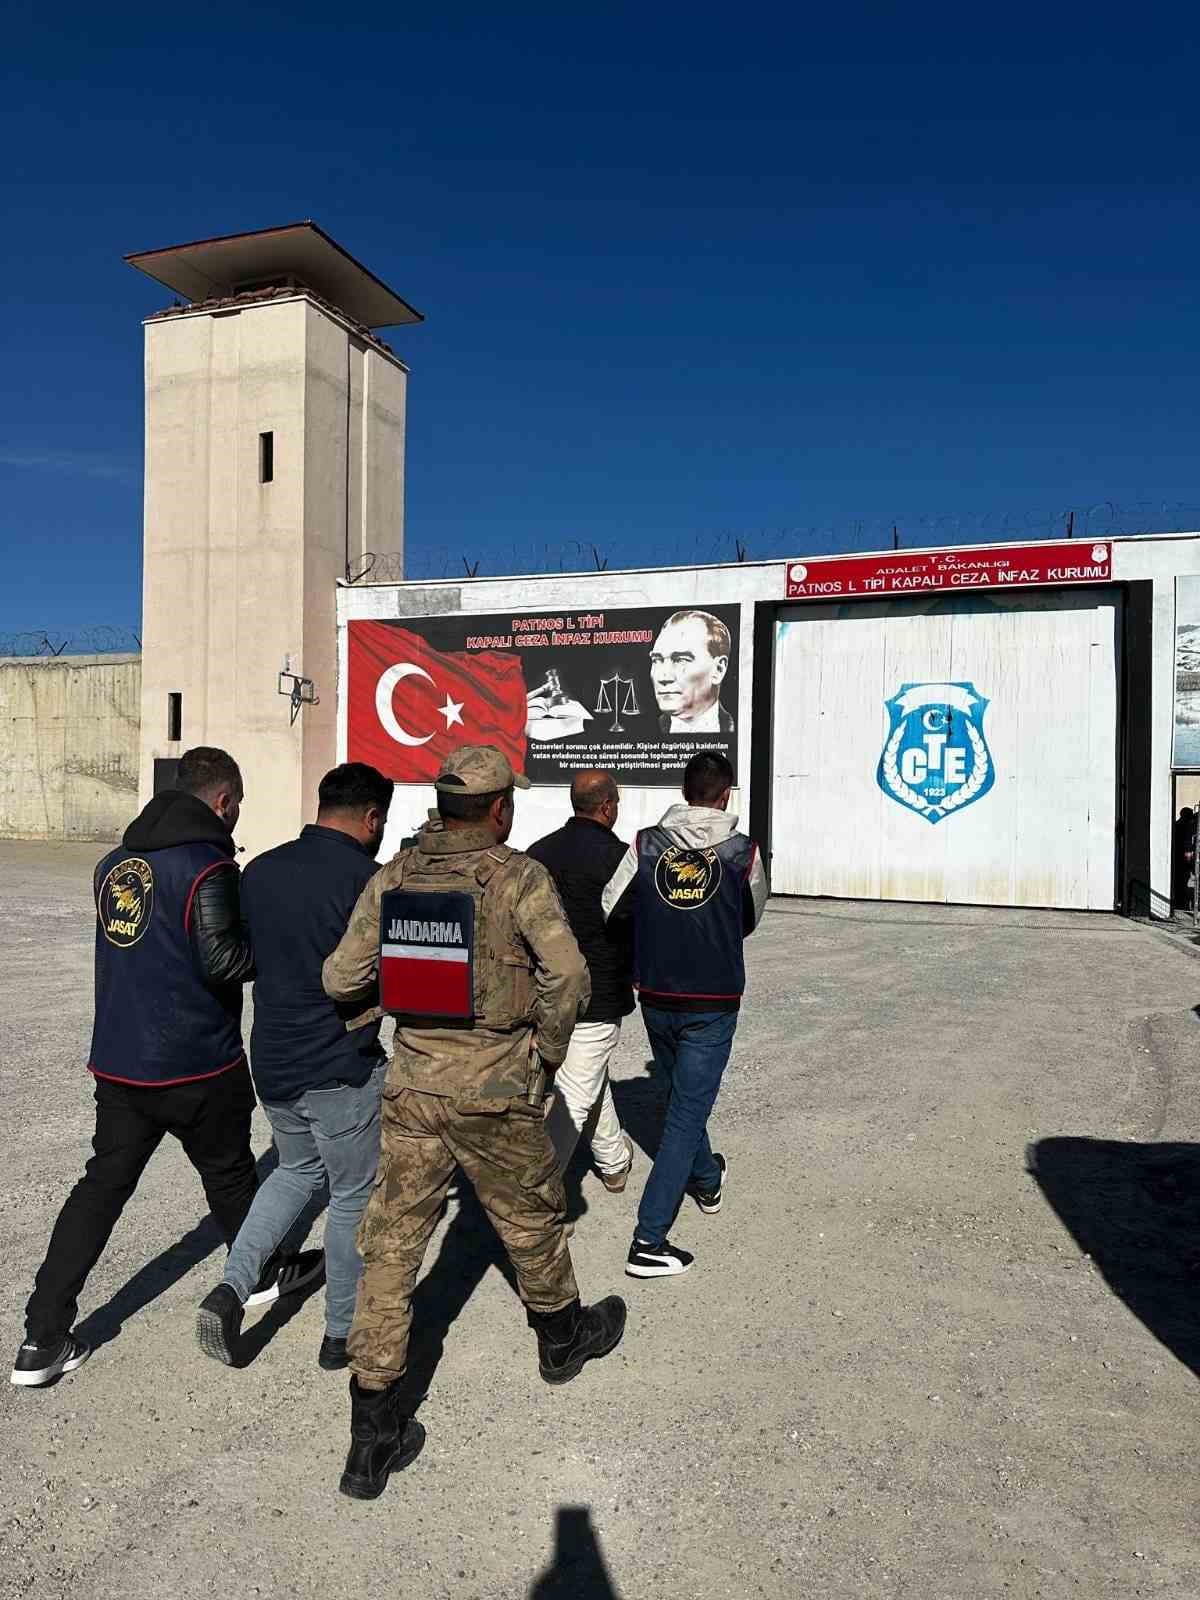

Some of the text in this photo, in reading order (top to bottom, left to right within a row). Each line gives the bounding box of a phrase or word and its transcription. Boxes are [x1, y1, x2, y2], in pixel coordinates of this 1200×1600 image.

[876, 565, 928, 575] ADALET
[788, 566, 1109, 595] PATNOS L TİPİ KAPALI CEZA İNFAZ KURUMU
[511, 614, 604, 632] PATNOS L TİPİ
[466, 630, 653, 649] KAPALI CEZA İNFAZ KURUMU
[588, 743, 601, 751] çok
[559, 761, 569, 769] bir
[594, 761, 616, 769] olarak
[668, 888, 706, 900] JASAT
[107, 919, 138, 937] JASAT
[388, 918, 463, 944] JANDARMA
